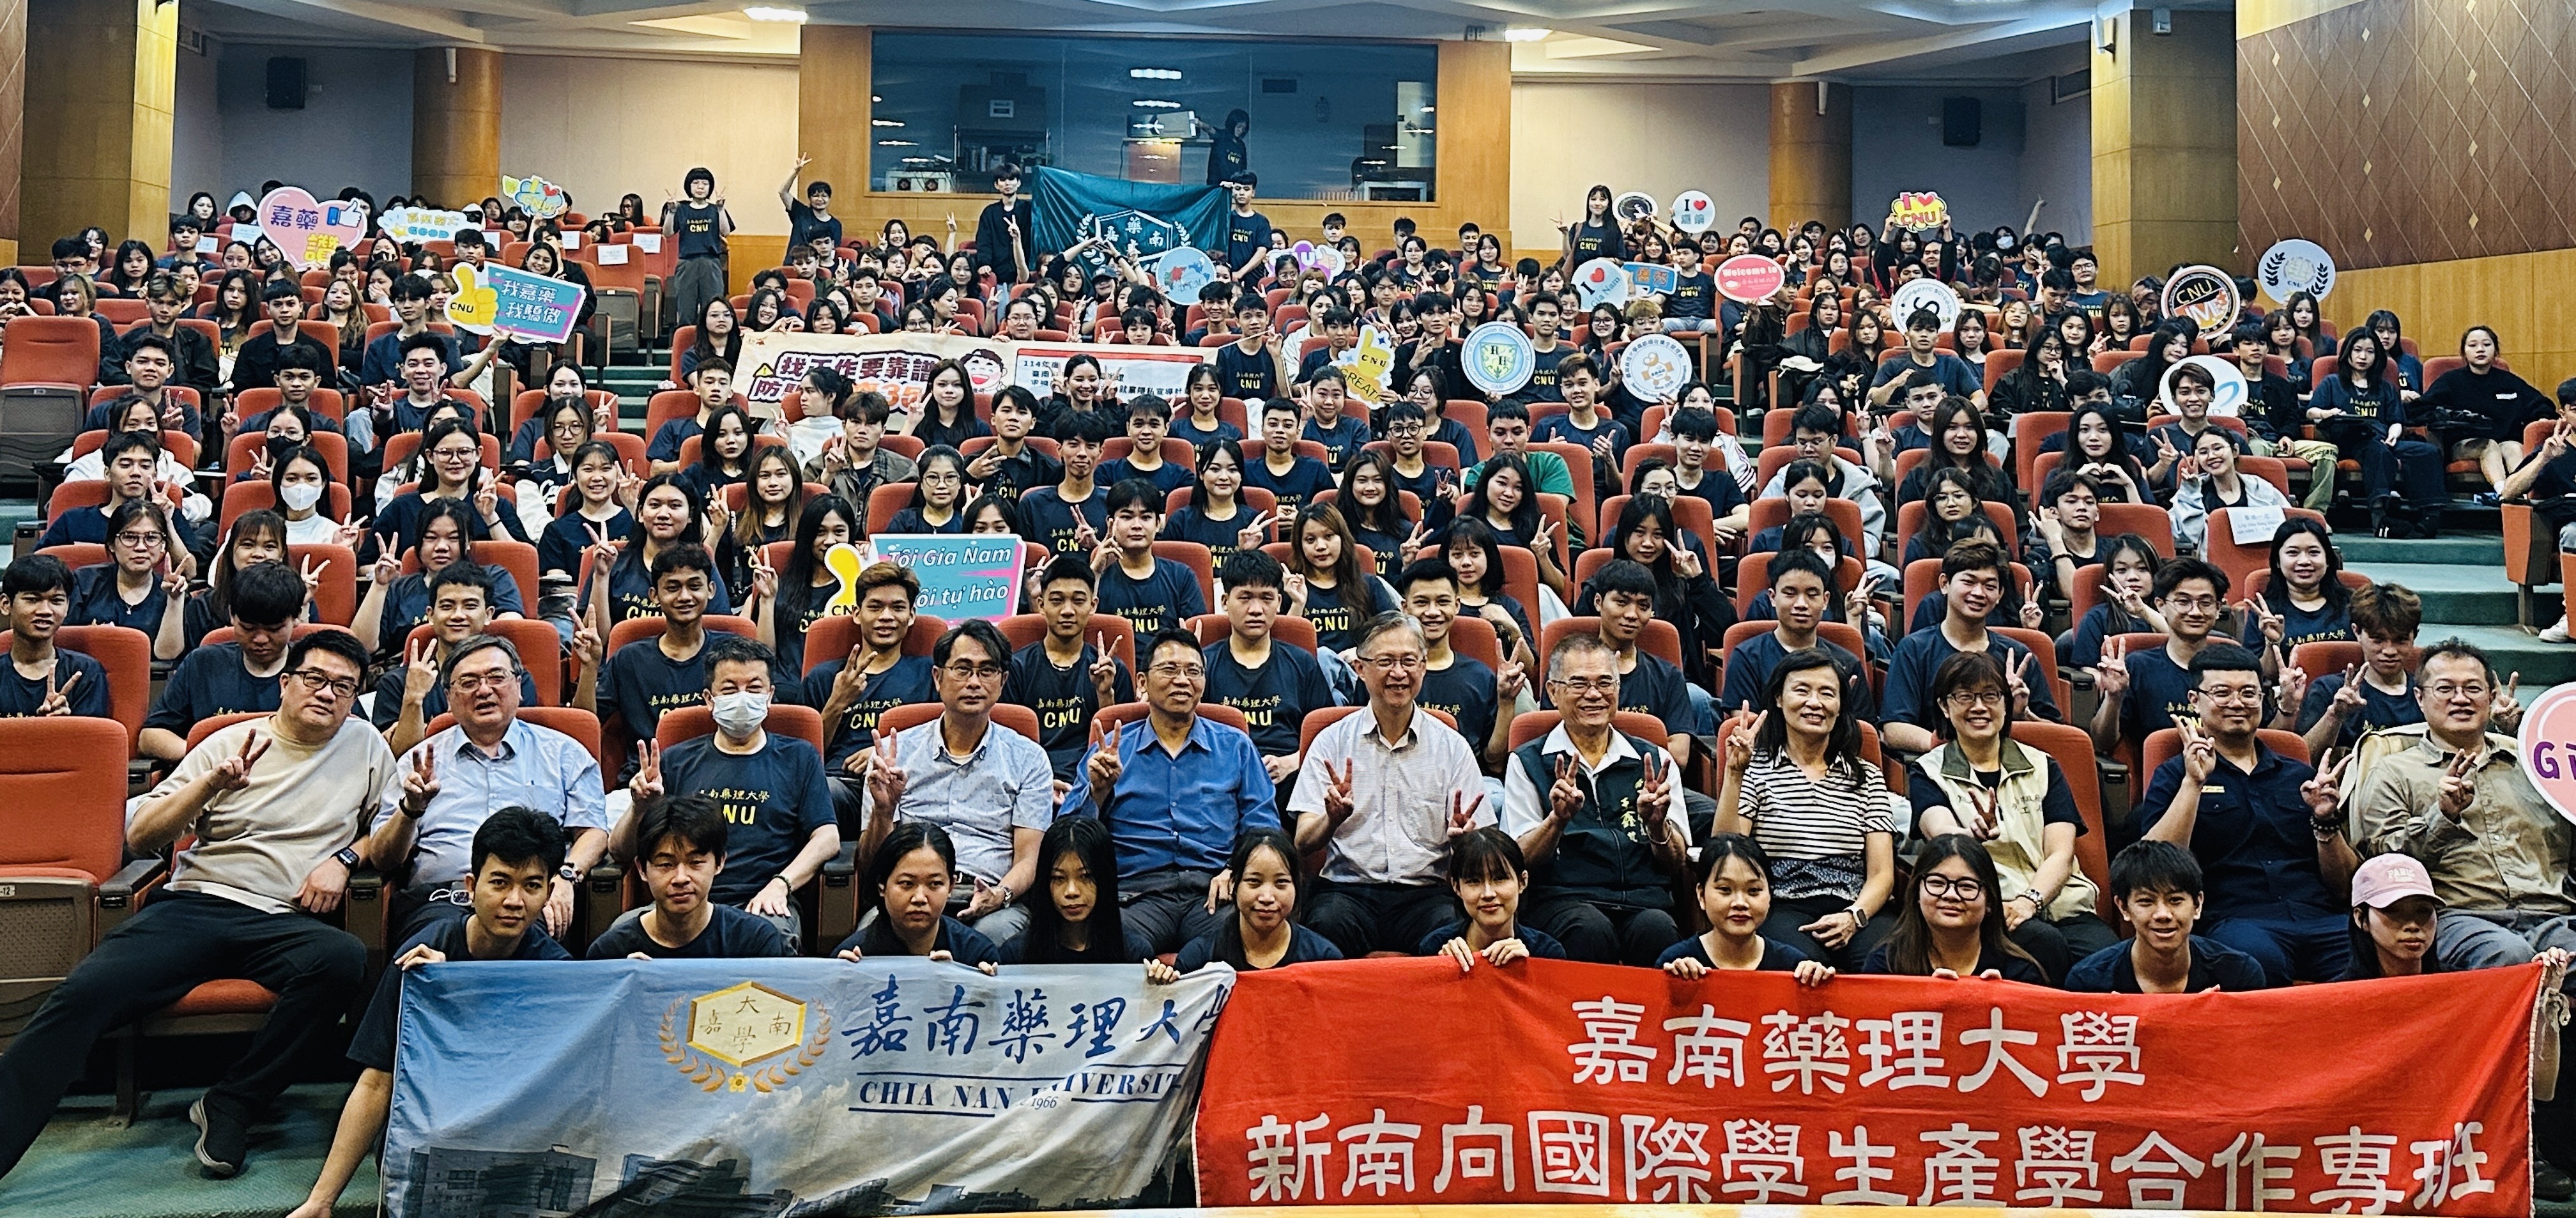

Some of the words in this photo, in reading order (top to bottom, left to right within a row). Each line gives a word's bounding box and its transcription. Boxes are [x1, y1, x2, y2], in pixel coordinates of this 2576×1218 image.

[1683, 199, 1690, 211] I
[1903, 194, 1912, 211] I
[270, 205, 319, 230] 嘉藥
[1901, 208, 1936, 226] CNU
[690, 224, 709, 233] CNU
[1579, 242, 1597, 251] CNU
[1722, 267, 1766, 277] Welcome
[1767, 266, 1778, 274] to
[502, 279, 558, 304] 我嘉藥
[1602, 276, 1621, 295] Nam
[2176, 279, 2213, 304] CNU
[450, 302, 474, 314] CNU
[1361, 354, 1387, 367] CNU
[1240, 378, 1261, 389] CNU
[1533, 375, 1555, 385] CNU
[2354, 406, 2377, 417] CNU
[999, 486, 1018, 499] CN
[887, 548, 920, 568] Tôi
[923, 546, 958, 567] Gia
[962, 546, 1012, 565] Nam
[916, 587, 938, 608] ôi
[942, 585, 967, 610] tự
[968, 578, 1009, 603] hào
[832, 605, 854, 615] CN
[1131, 617, 1159, 633] NU
[1312, 615, 1349, 632] CNU
[648, 692, 704, 707] 嘉南藥理大
[1036, 696, 1085, 708] 嘉南藥理大
[1044, 707, 1080, 729] CNU
[1245, 709, 1272, 727] NU
[700, 787, 770, 803] 南藥理大學
[723, 804, 756, 825] NU
[2387, 867, 2414, 878] PARIS
[740, 995, 760, 1015] 大
[700, 1008, 723, 1035] 嘉
[768, 1011, 791, 1036] 南
[732, 1025, 757, 1054] 學
[1568, 994, 2145, 1103] 嘉南藥理大學
[859, 1080, 935, 1107] CHIA
[951, 1084, 1015, 1109] NAN
[1032, 1072, 1181, 1095] IVERSIT
[1030, 1095, 1058, 1110] 1966
[1246, 1104, 2496, 1216] 新南向國際學生產學合作專班
